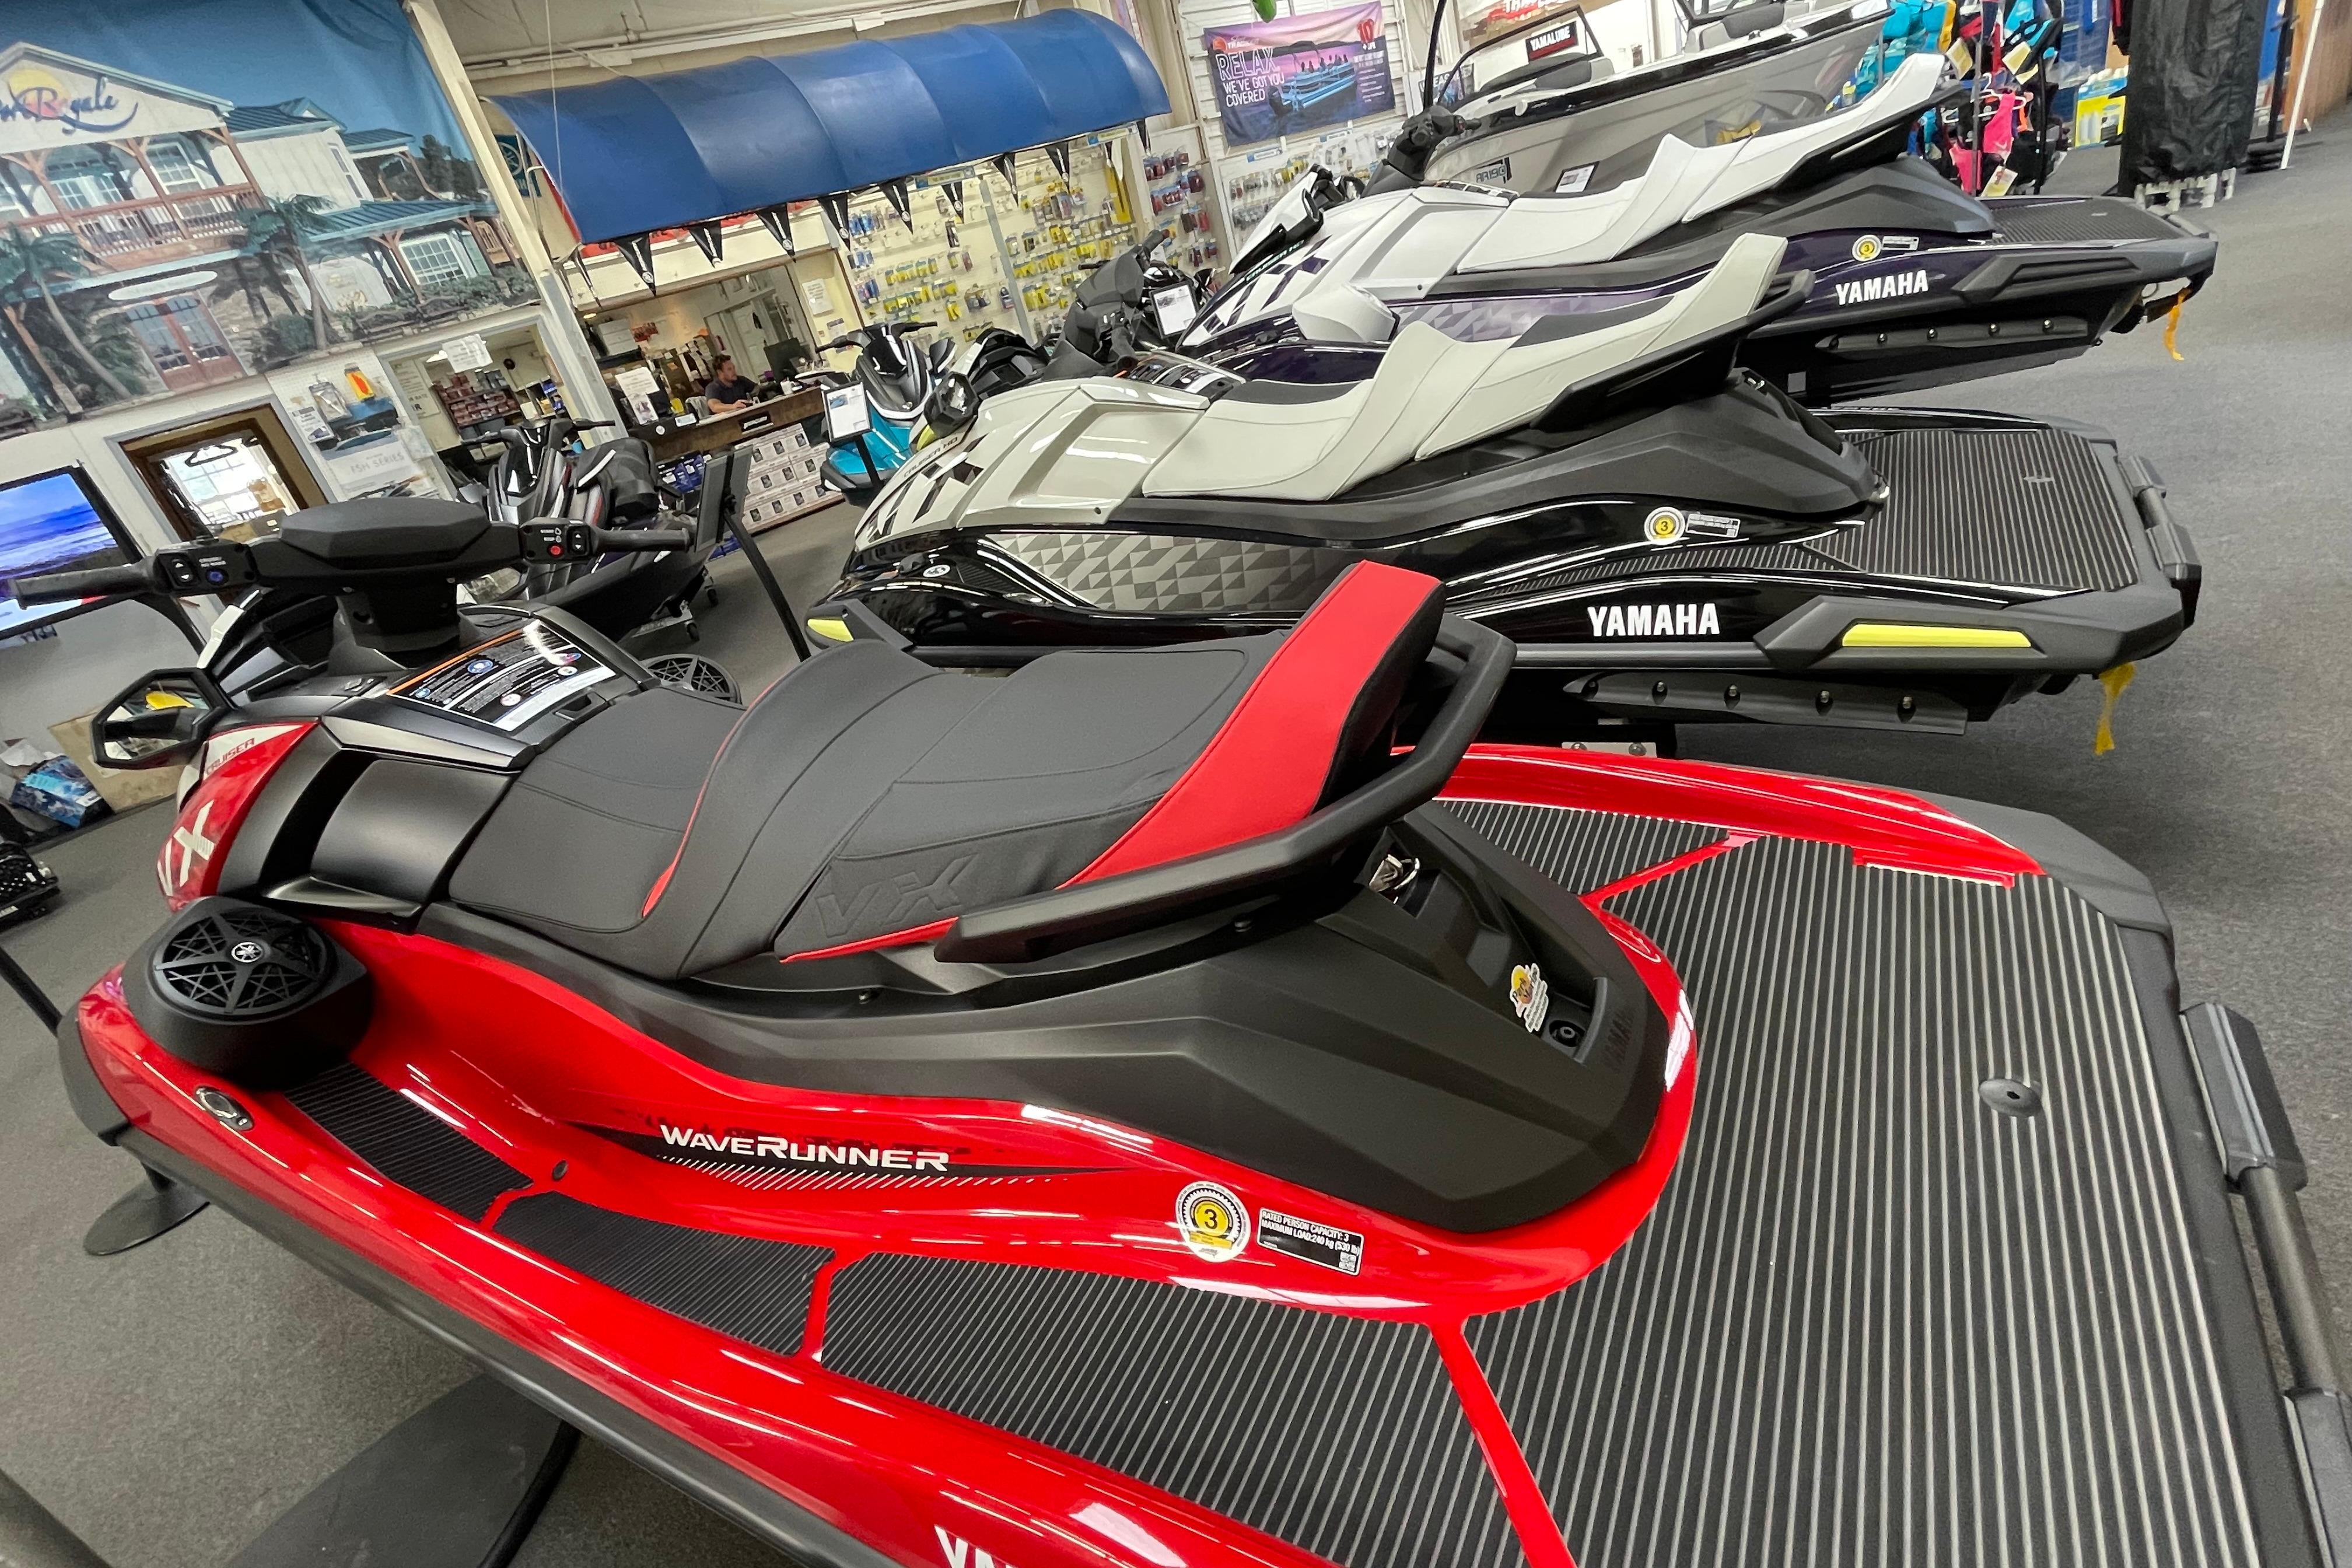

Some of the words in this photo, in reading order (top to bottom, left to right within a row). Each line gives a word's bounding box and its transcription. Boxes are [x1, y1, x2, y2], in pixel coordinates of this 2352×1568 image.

[1530, 26, 1570, 51] YAMALUBE
[1223, 78, 1251, 94] WE'VE
[1252, 75, 1268, 89] GOT
[1267, 72, 1284, 86] YOU
[1226, 88, 1265, 107] COVERED
[1835, 270, 1929, 305] YAMAHA
[373, 452, 405, 467] SERIES
[1660, 521, 1668, 531] 3
[1587, 603, 1720, 636] YAMAHA
[206, 737, 255, 776] CRUISER
[1205, 1209, 1217, 1230] 3
[1262, 1210, 1282, 1223] RATED
[1283, 1217, 1310, 1231] PERSON
[1344, 1234, 1349, 1242] 3
[1261, 1219, 1293, 1236] MAXIMUM
[1325, 1238, 1335, 1250] kg
